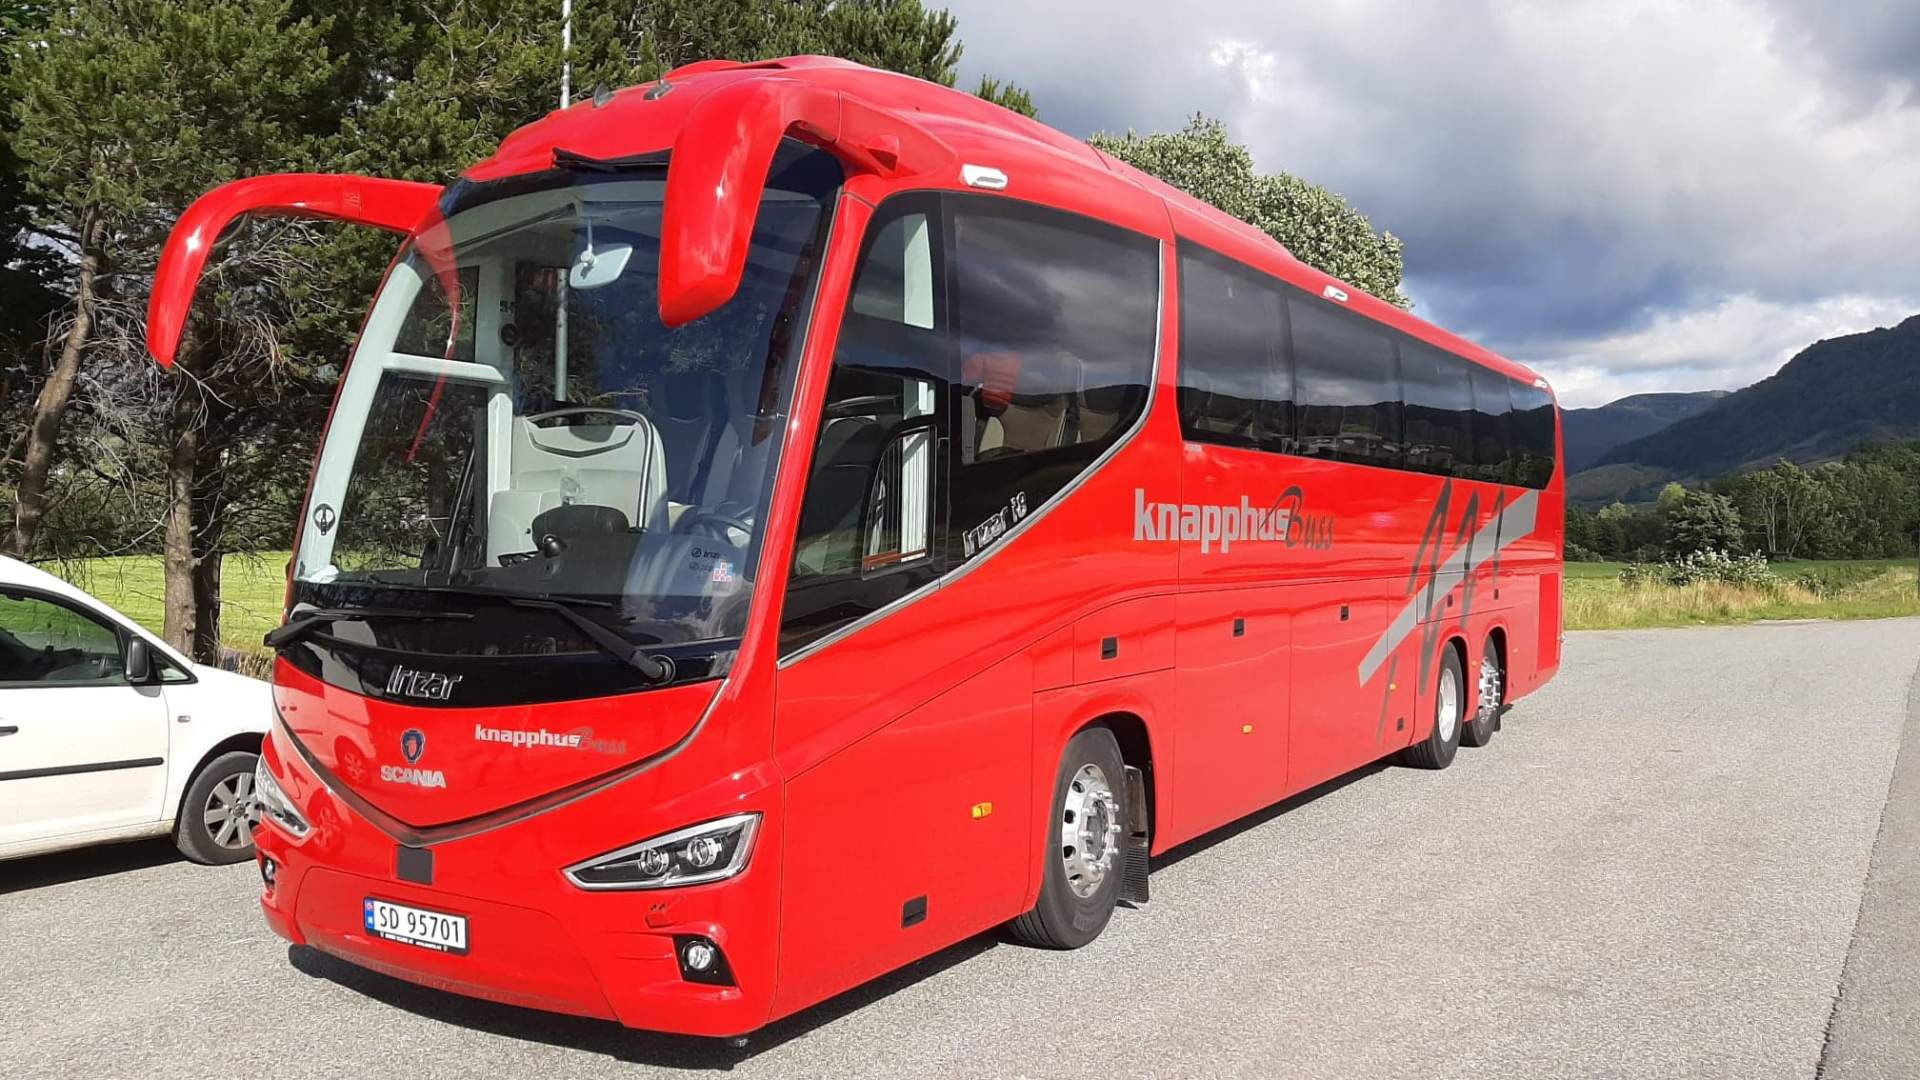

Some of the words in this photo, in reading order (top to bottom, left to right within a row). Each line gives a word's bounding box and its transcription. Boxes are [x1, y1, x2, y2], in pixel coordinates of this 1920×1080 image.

[962, 505, 1008, 558] Irizar
[1134, 488, 1290, 554] knapphus
[1260, 485, 1334, 549] Buss
[386, 665, 463, 700] Irizar
[475, 724, 581, 748] knapphus
[380, 765, 447, 788] SCANIA
[379, 906, 399, 930] SD
[407, 912, 459, 943] 95701
